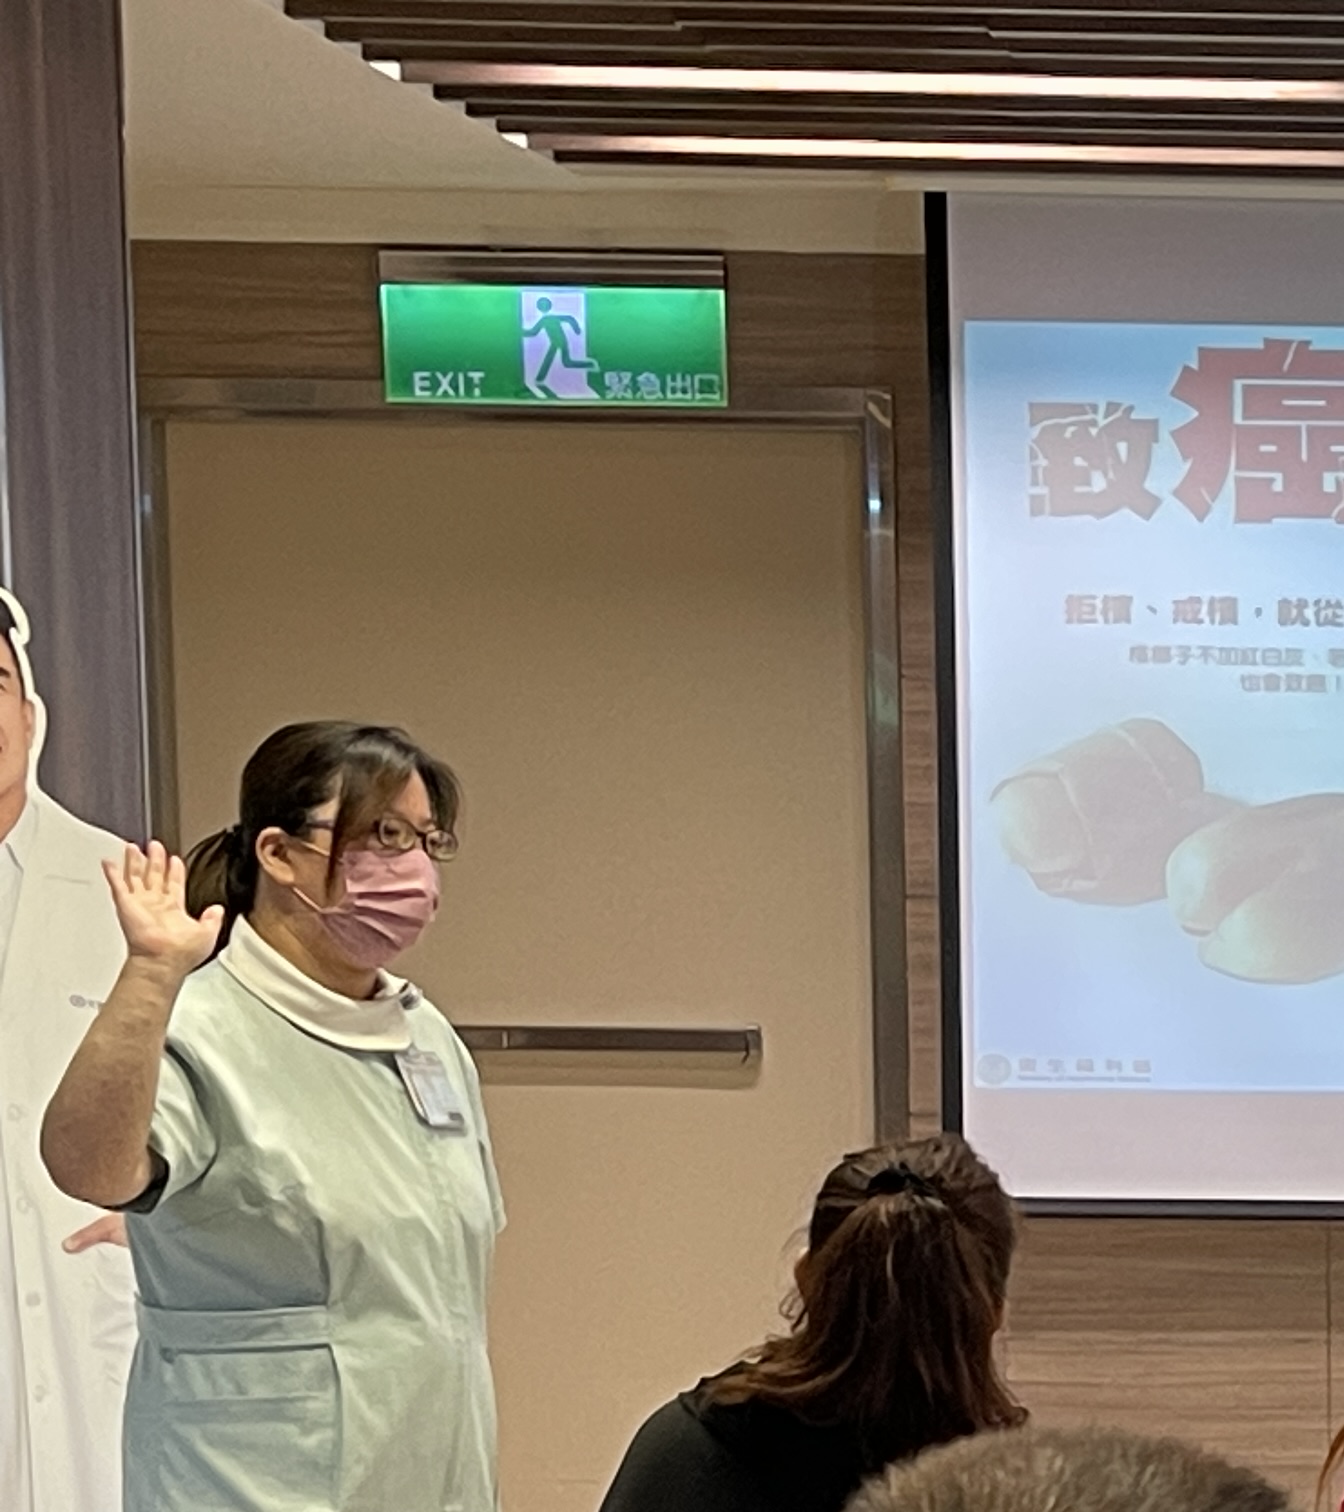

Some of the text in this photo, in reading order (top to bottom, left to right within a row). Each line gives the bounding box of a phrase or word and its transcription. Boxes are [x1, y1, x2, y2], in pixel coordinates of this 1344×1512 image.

[412, 371, 486, 397] EXIT
[603, 371, 721, 400] 緊急出口
